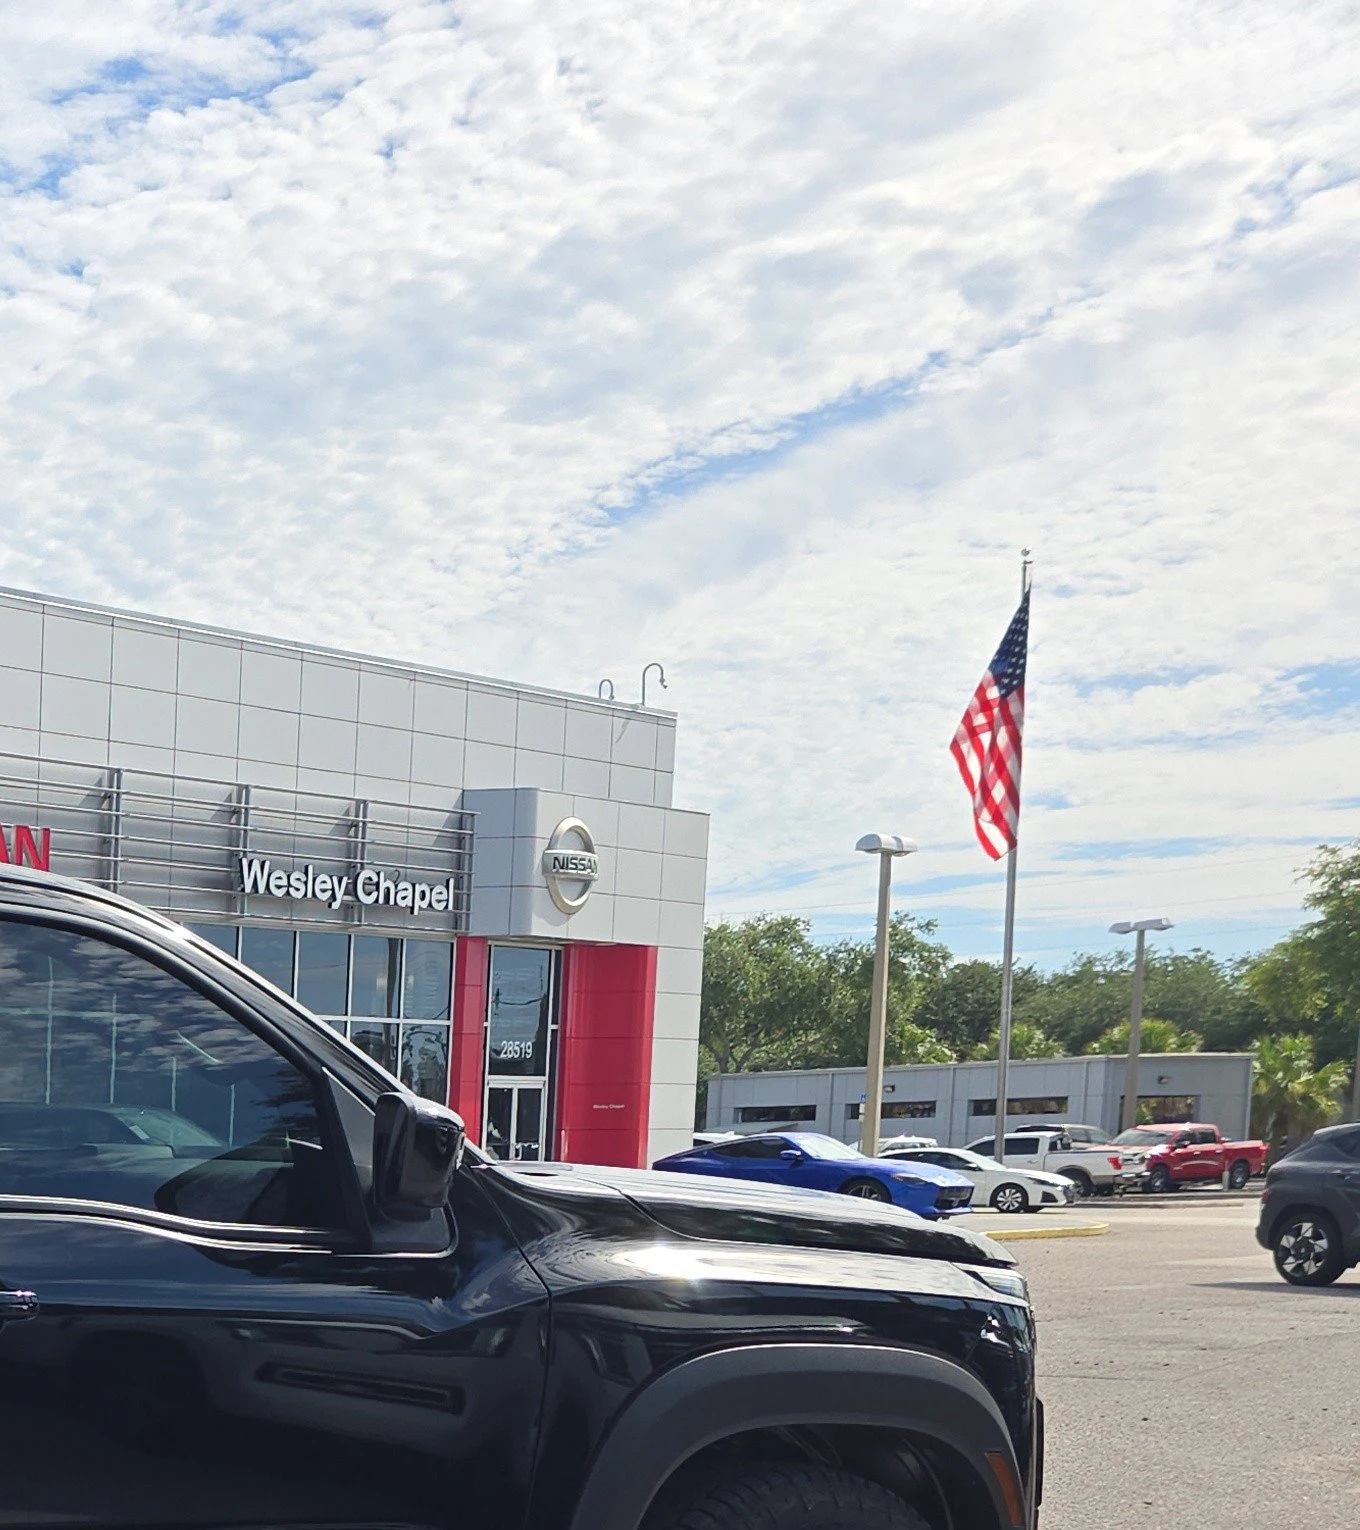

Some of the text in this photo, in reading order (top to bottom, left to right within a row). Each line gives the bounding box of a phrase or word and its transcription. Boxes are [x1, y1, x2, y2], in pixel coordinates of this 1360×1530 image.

[241, 857, 455, 915] Wesley Chapel
[500, 1040, 533, 1059] 28519
